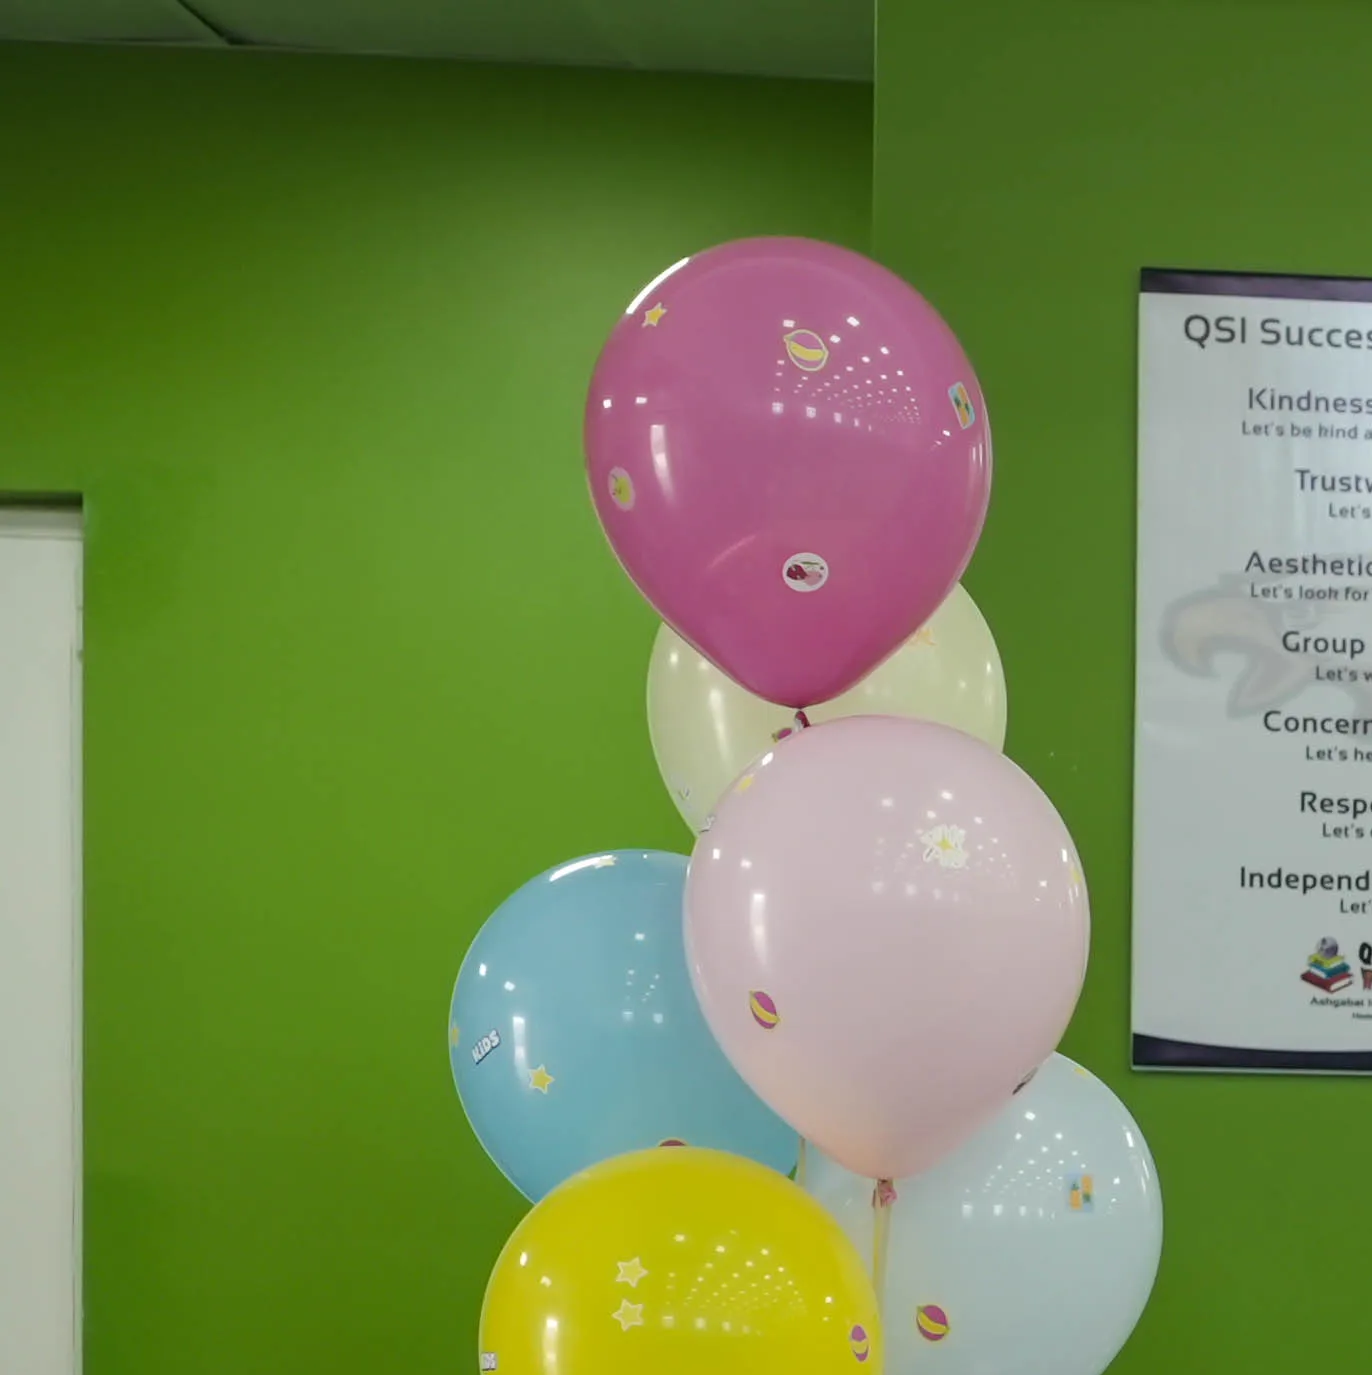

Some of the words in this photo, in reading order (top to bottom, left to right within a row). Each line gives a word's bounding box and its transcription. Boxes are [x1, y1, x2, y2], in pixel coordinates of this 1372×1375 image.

[1184, 314, 1247, 349] QSI
[1242, 421, 1284, 436] Let's
[1291, 423, 1312, 437] be
[1318, 423, 1358, 440] kind
[1328, 503, 1371, 519] Let's
[1250, 582, 1293, 600] Let's
[1299, 583, 1339, 601] look
[1344, 585, 1369, 602] for
[1282, 630, 1365, 659] Group
[1315, 665, 1358, 682] Let's
[1306, 745, 1348, 762] Let's
[1322, 823, 1364, 839] Let's
